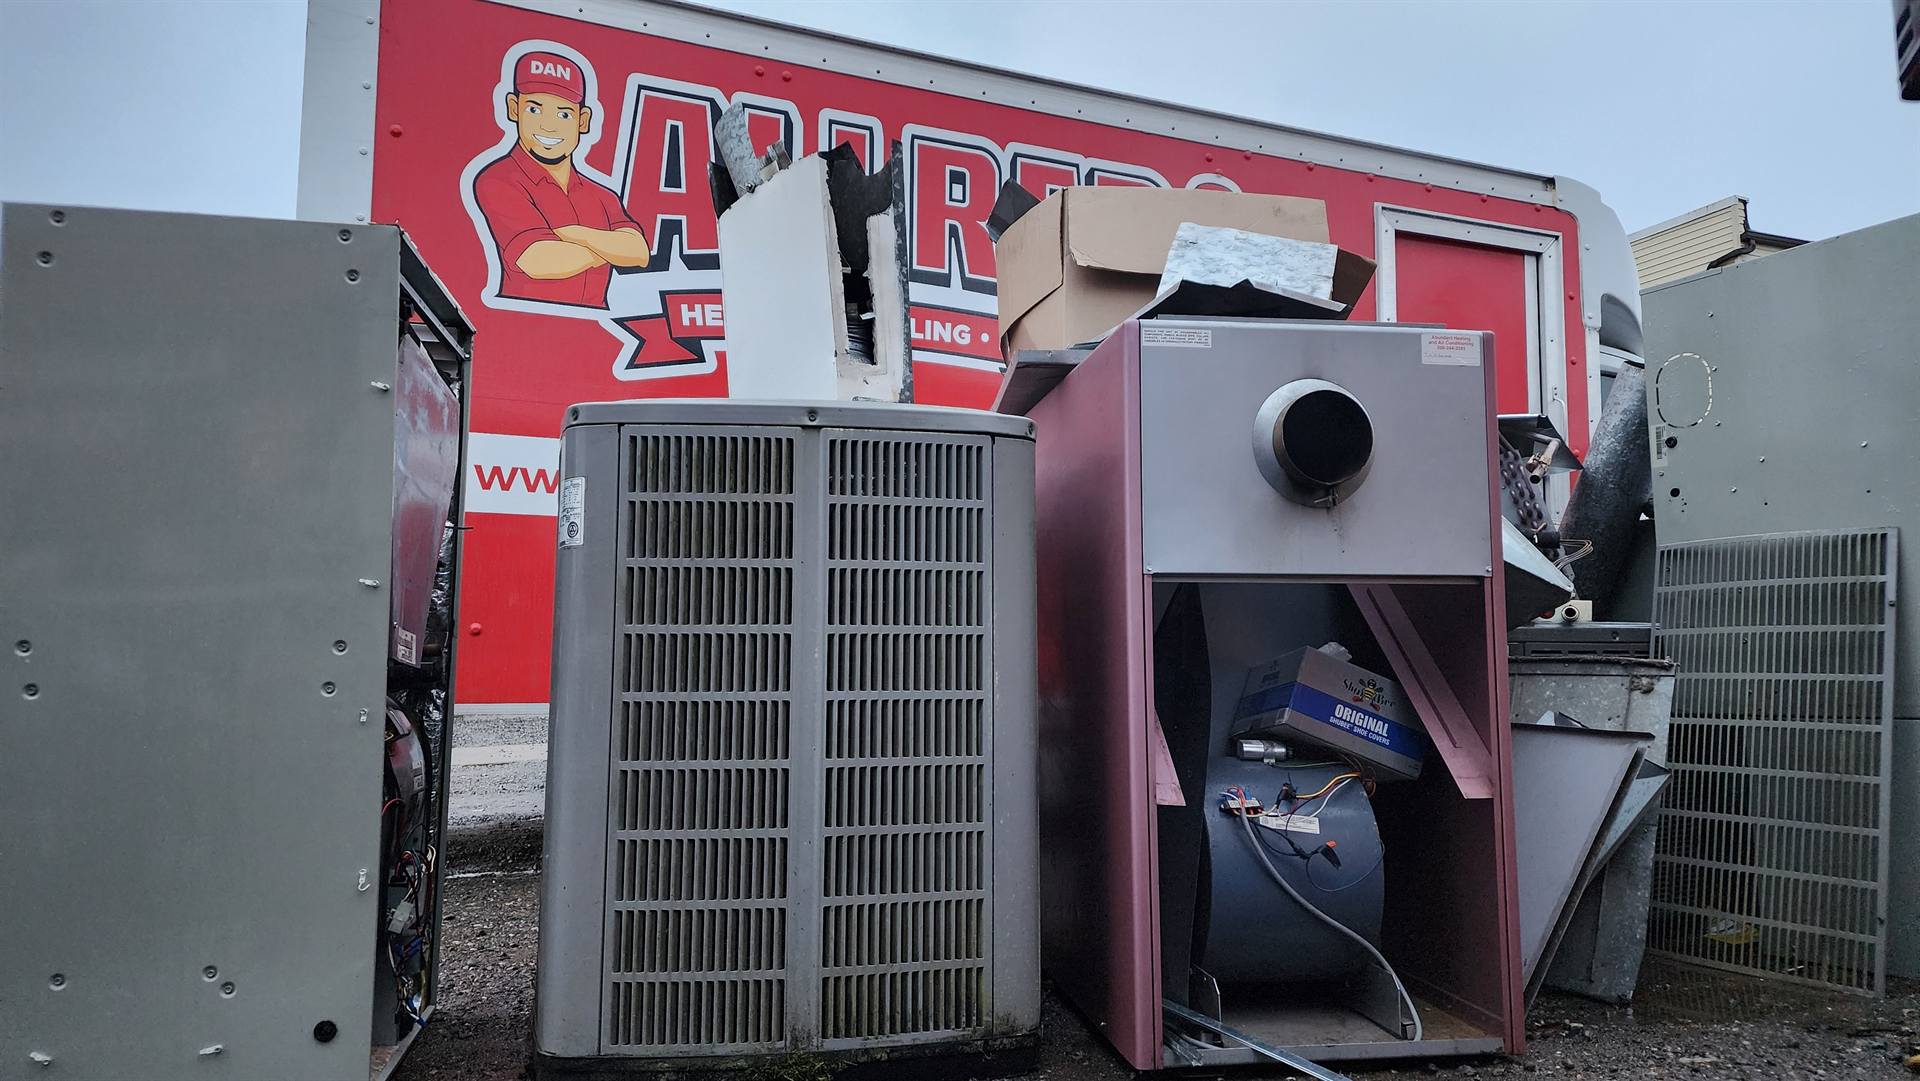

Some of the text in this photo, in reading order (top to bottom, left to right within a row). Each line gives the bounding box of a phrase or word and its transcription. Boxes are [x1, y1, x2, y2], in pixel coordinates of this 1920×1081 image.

[530, 60, 571, 81] DAN
[680, 303, 971, 346] HE LING
[474, 464, 560, 494] ww
[1334, 703, 1389, 737] ORIGINAL
[1353, 725, 1369, 737] SHOE
[1368, 732, 1391, 746] COVERS
